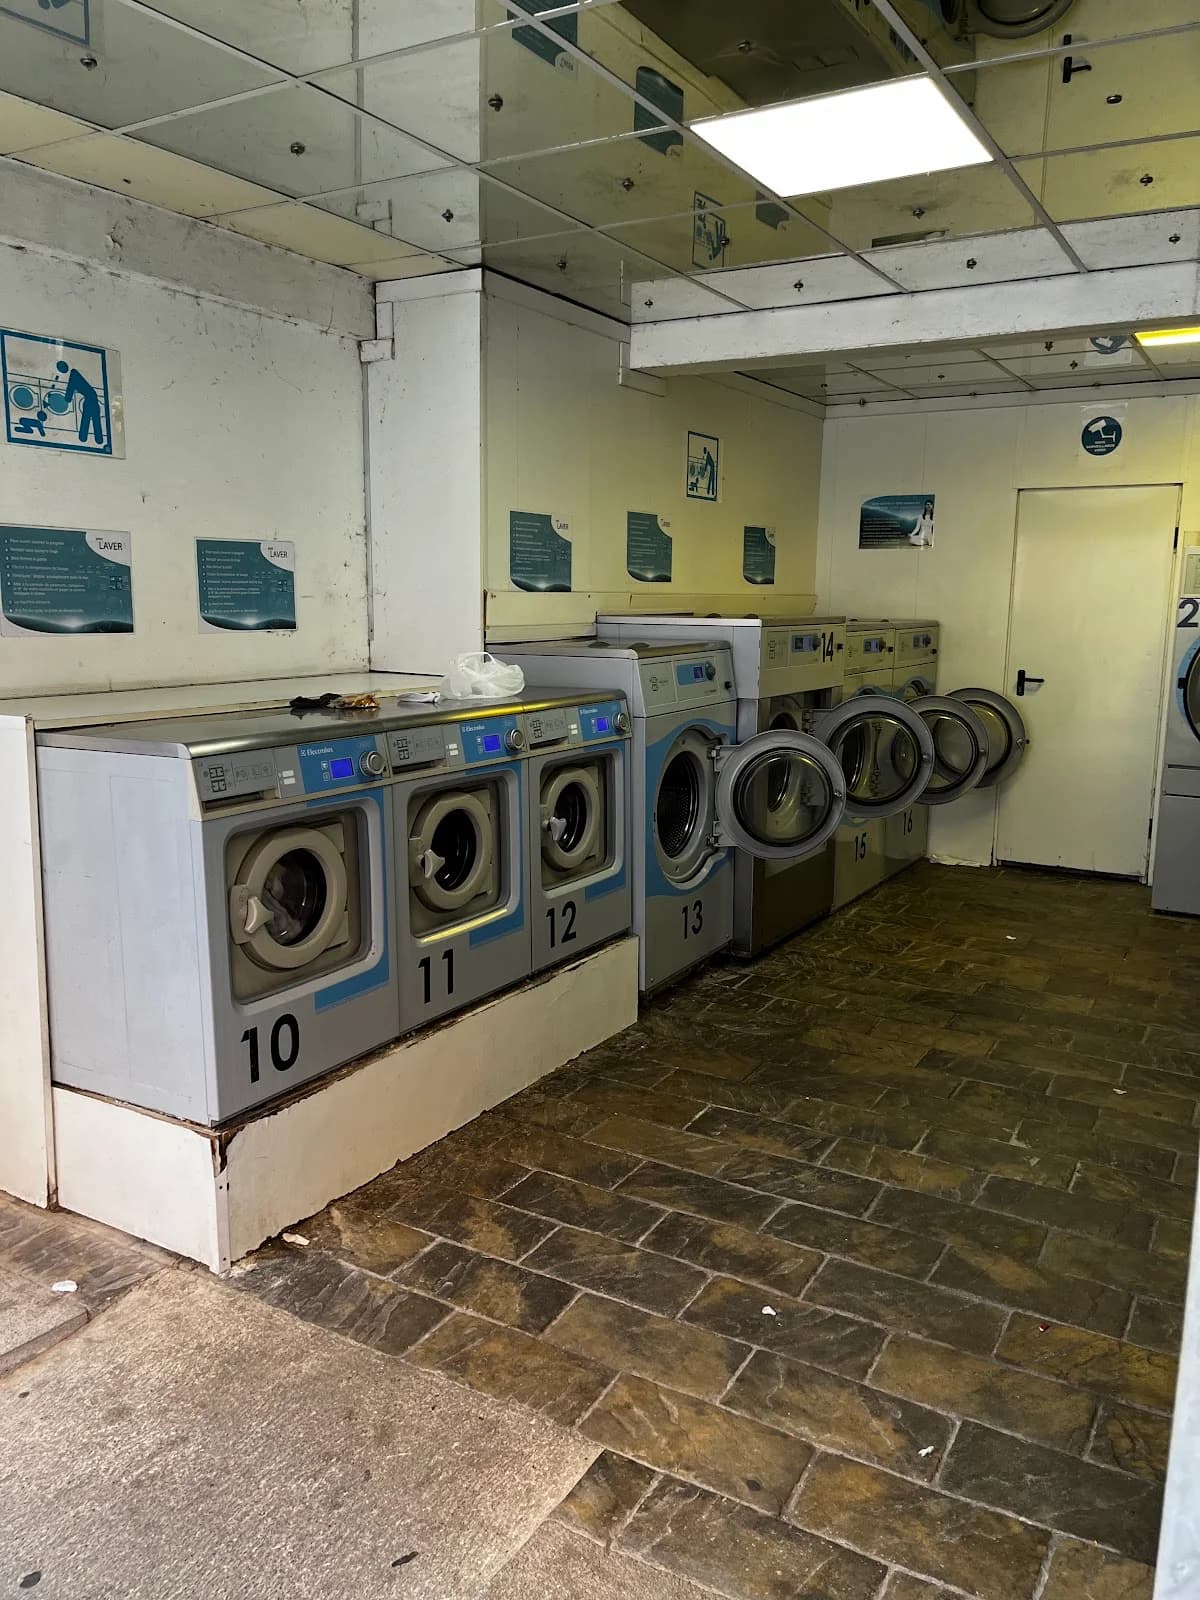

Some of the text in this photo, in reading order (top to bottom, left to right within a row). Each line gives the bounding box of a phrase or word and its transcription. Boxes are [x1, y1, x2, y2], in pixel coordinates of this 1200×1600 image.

[99, 542, 123, 551] LAVER
[270, 551, 288, 559] LAVER
[821, 631, 834, 663] 14
[306, 746, 334, 756] Electrolux
[903, 809, 913, 836] 16
[854, 832, 867, 863] 15
[546, 900, 577, 949] 12
[681, 899, 703, 940] 13
[418, 949, 454, 1005] 11
[240, 1013, 300, 1084] 10
